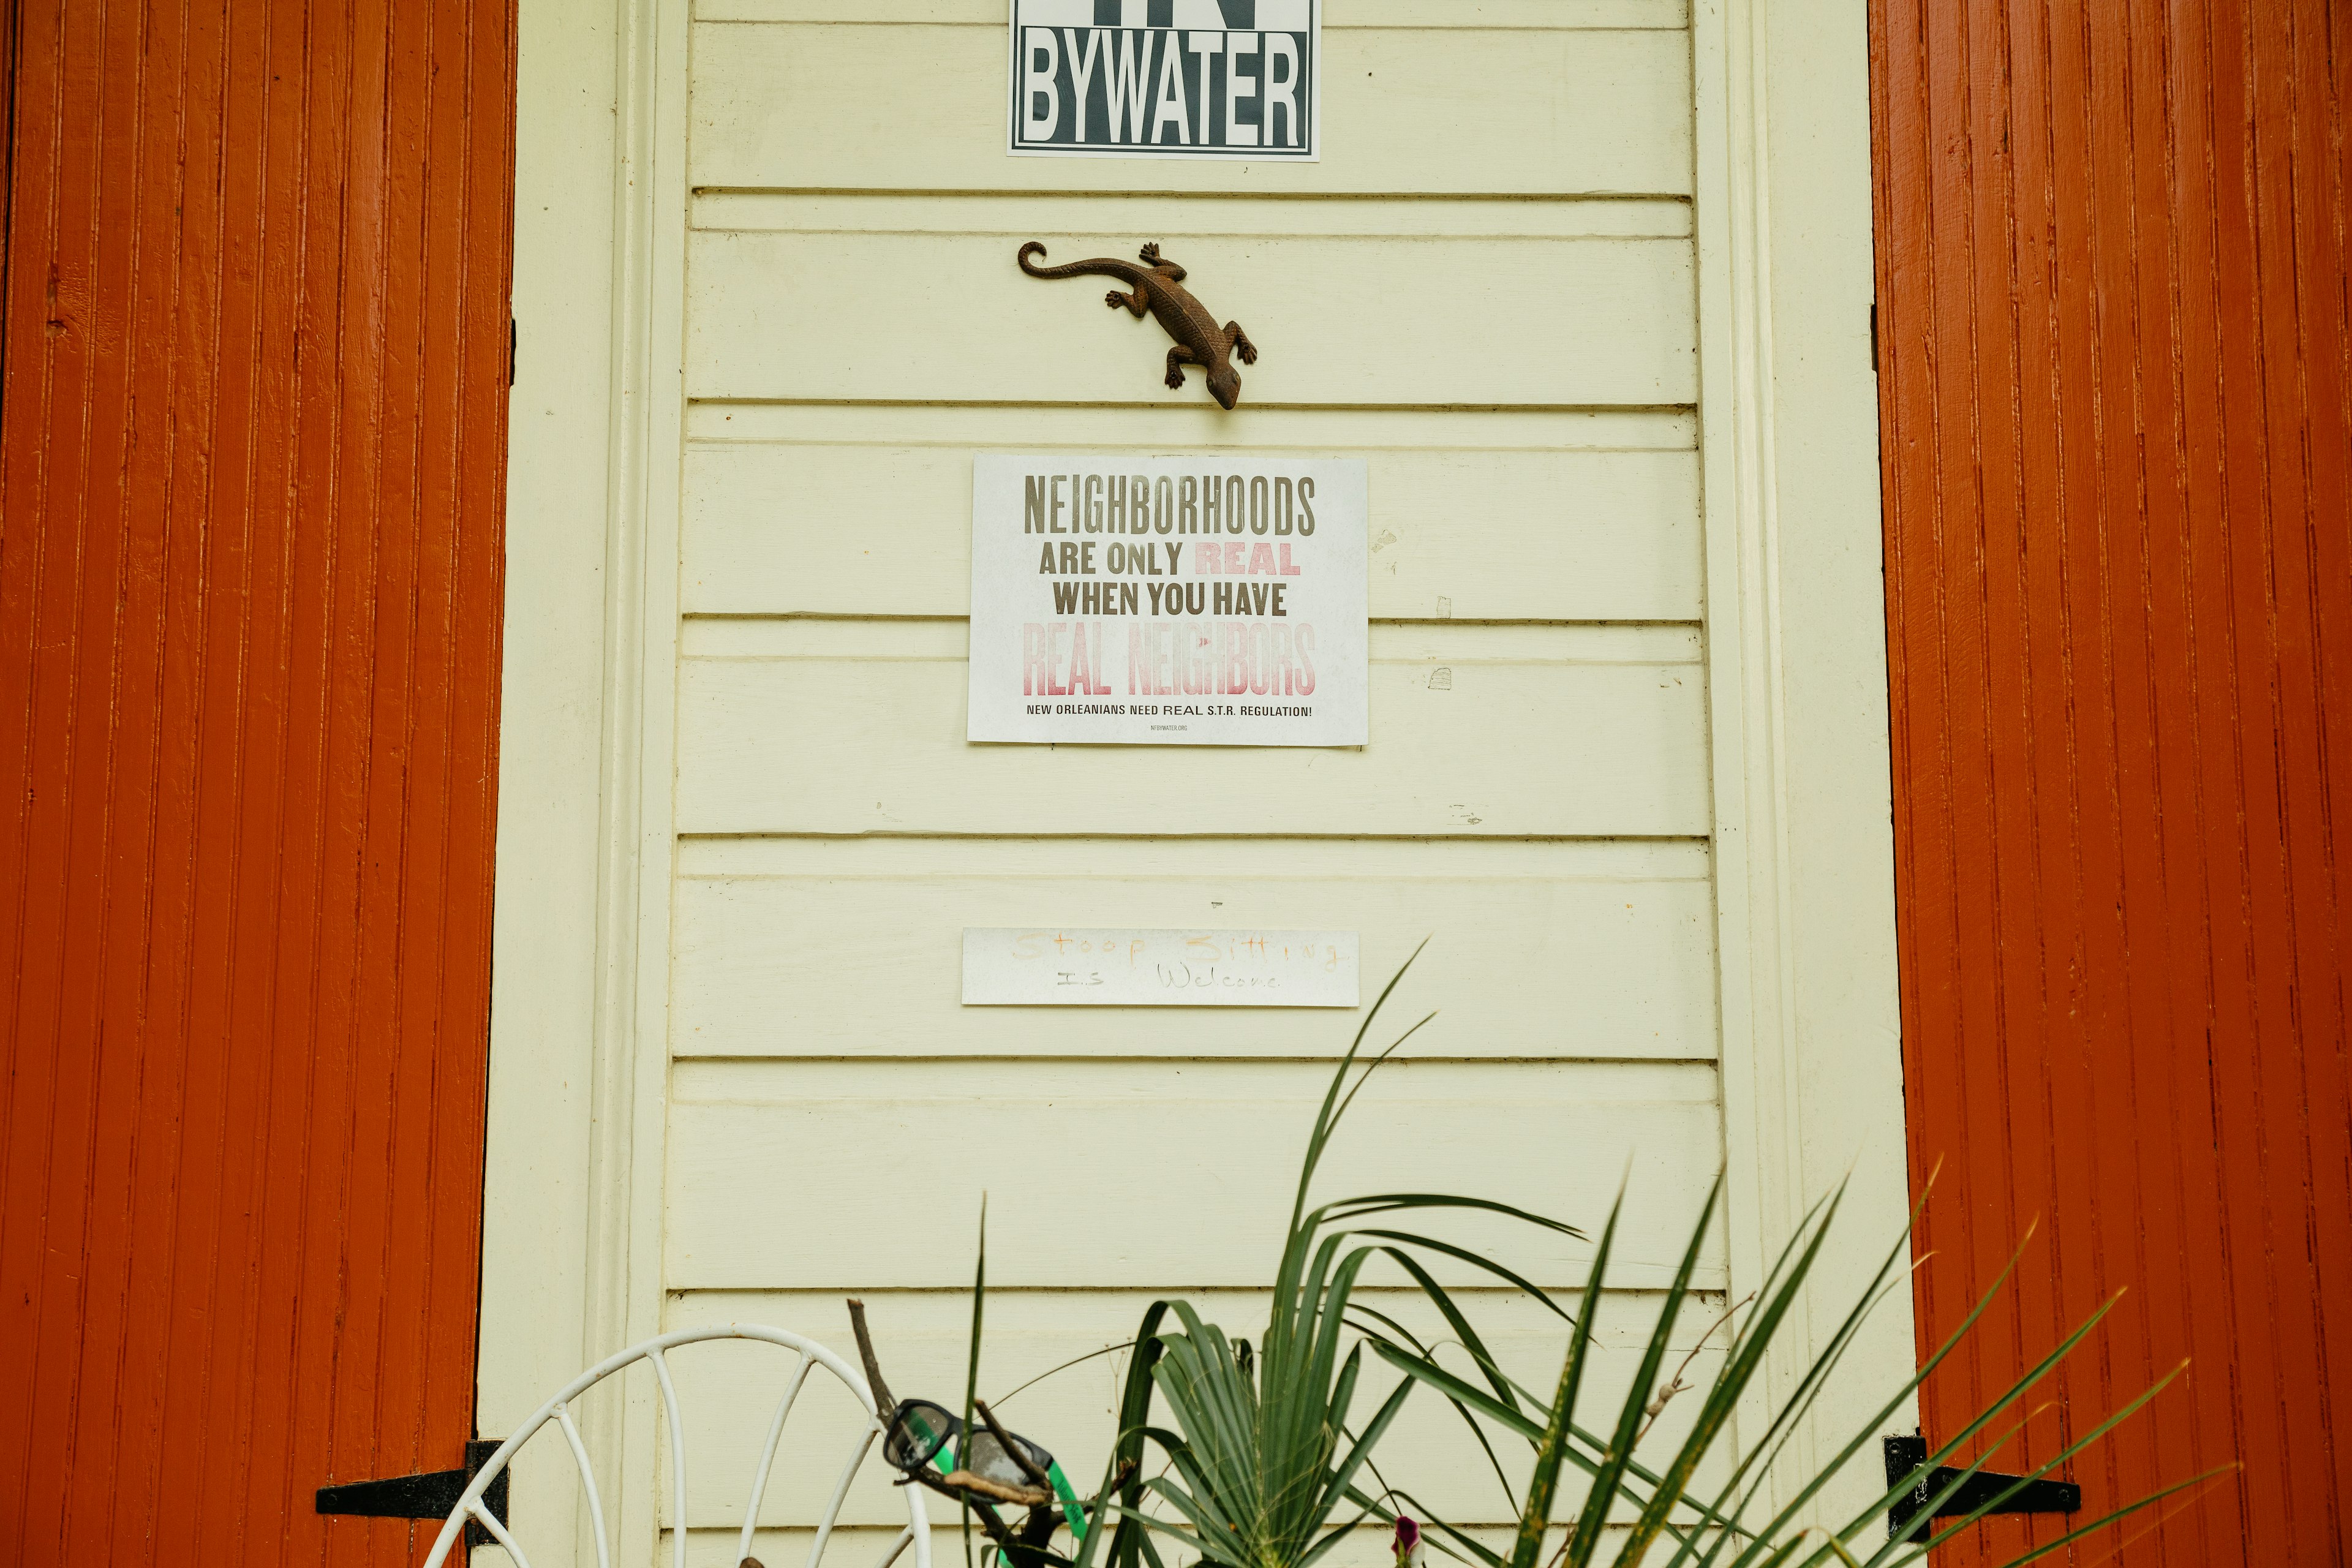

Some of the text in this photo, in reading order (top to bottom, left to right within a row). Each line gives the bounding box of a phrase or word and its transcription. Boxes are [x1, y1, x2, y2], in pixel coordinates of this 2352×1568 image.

[1023, 27, 1299, 146] BYWATER
[1025, 474, 1315, 537] NEIGHBORHOODS
[1039, 541, 1300, 575] ARE ONLY REAL
[1053, 582, 1286, 616] WHEN YOU HAVE
[1023, 622, 1315, 696] REAL NEIGHBORS
[1027, 705, 1311, 716] NEW ORLEANIANS NEED REAL S.T.R. REGULATION!
[1012, 931, 1145, 970] Stoop
